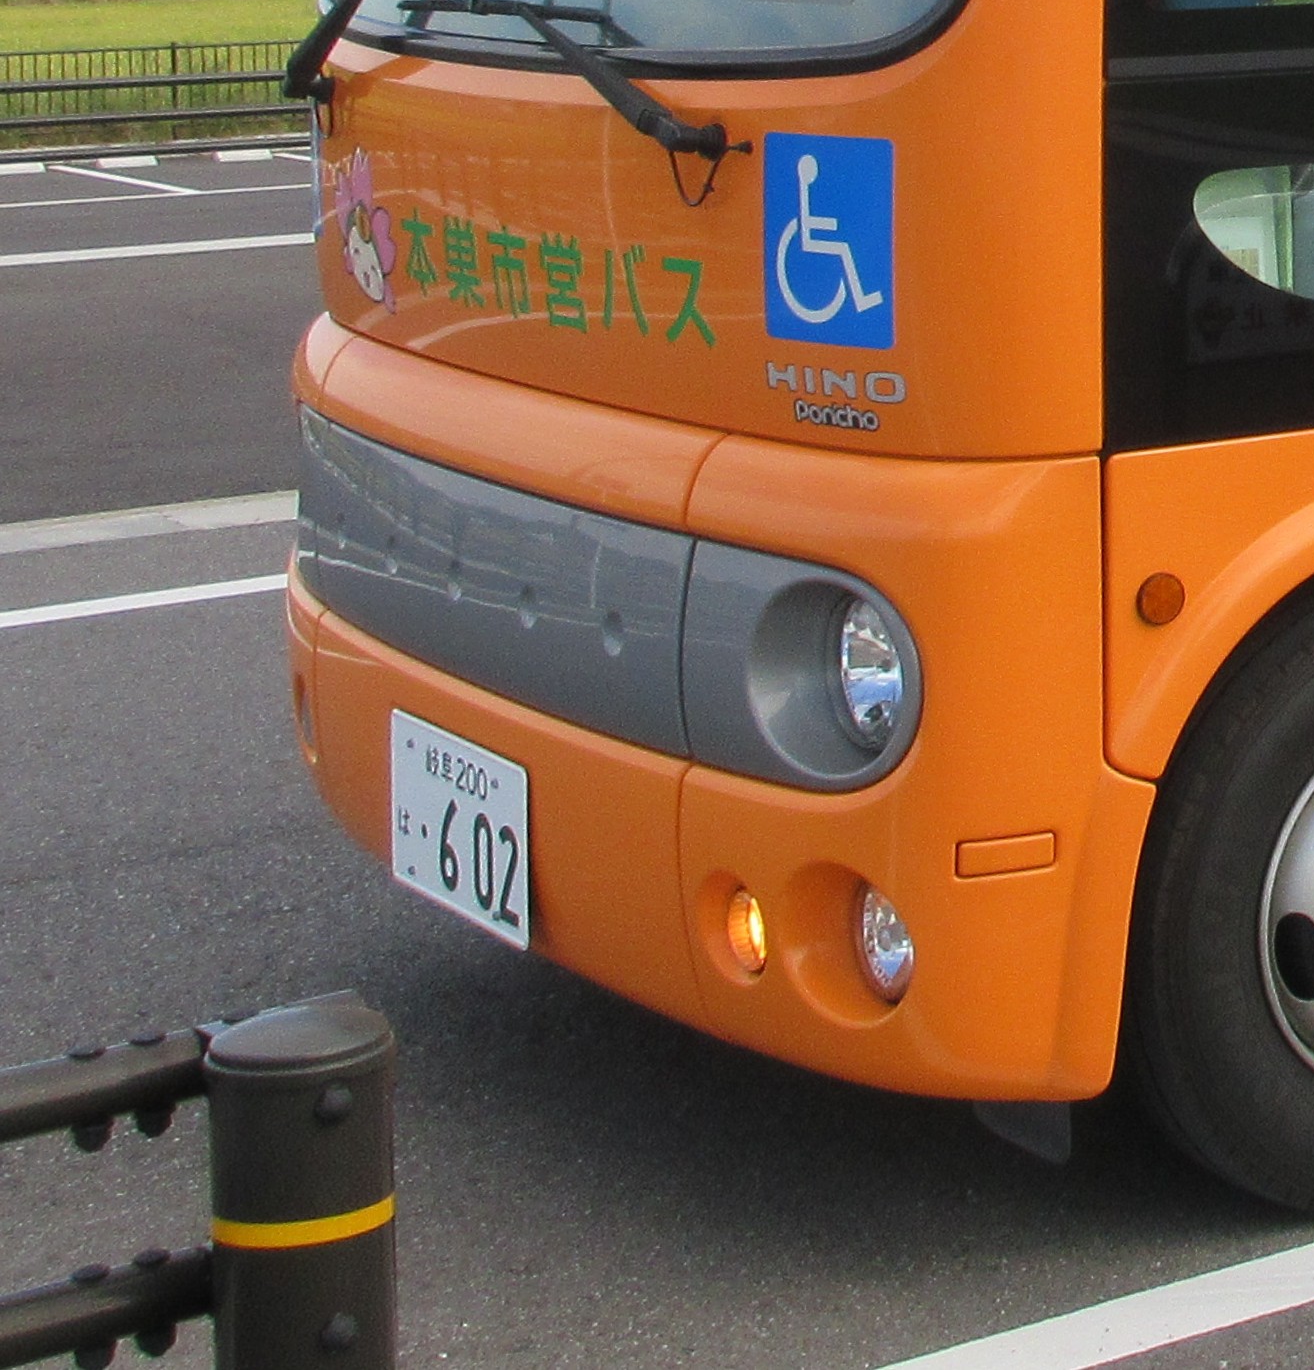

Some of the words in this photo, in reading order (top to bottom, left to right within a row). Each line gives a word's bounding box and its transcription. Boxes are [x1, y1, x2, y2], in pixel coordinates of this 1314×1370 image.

[400, 207, 717, 348] 本巣市営バス
[764, 361, 907, 405] HINO
